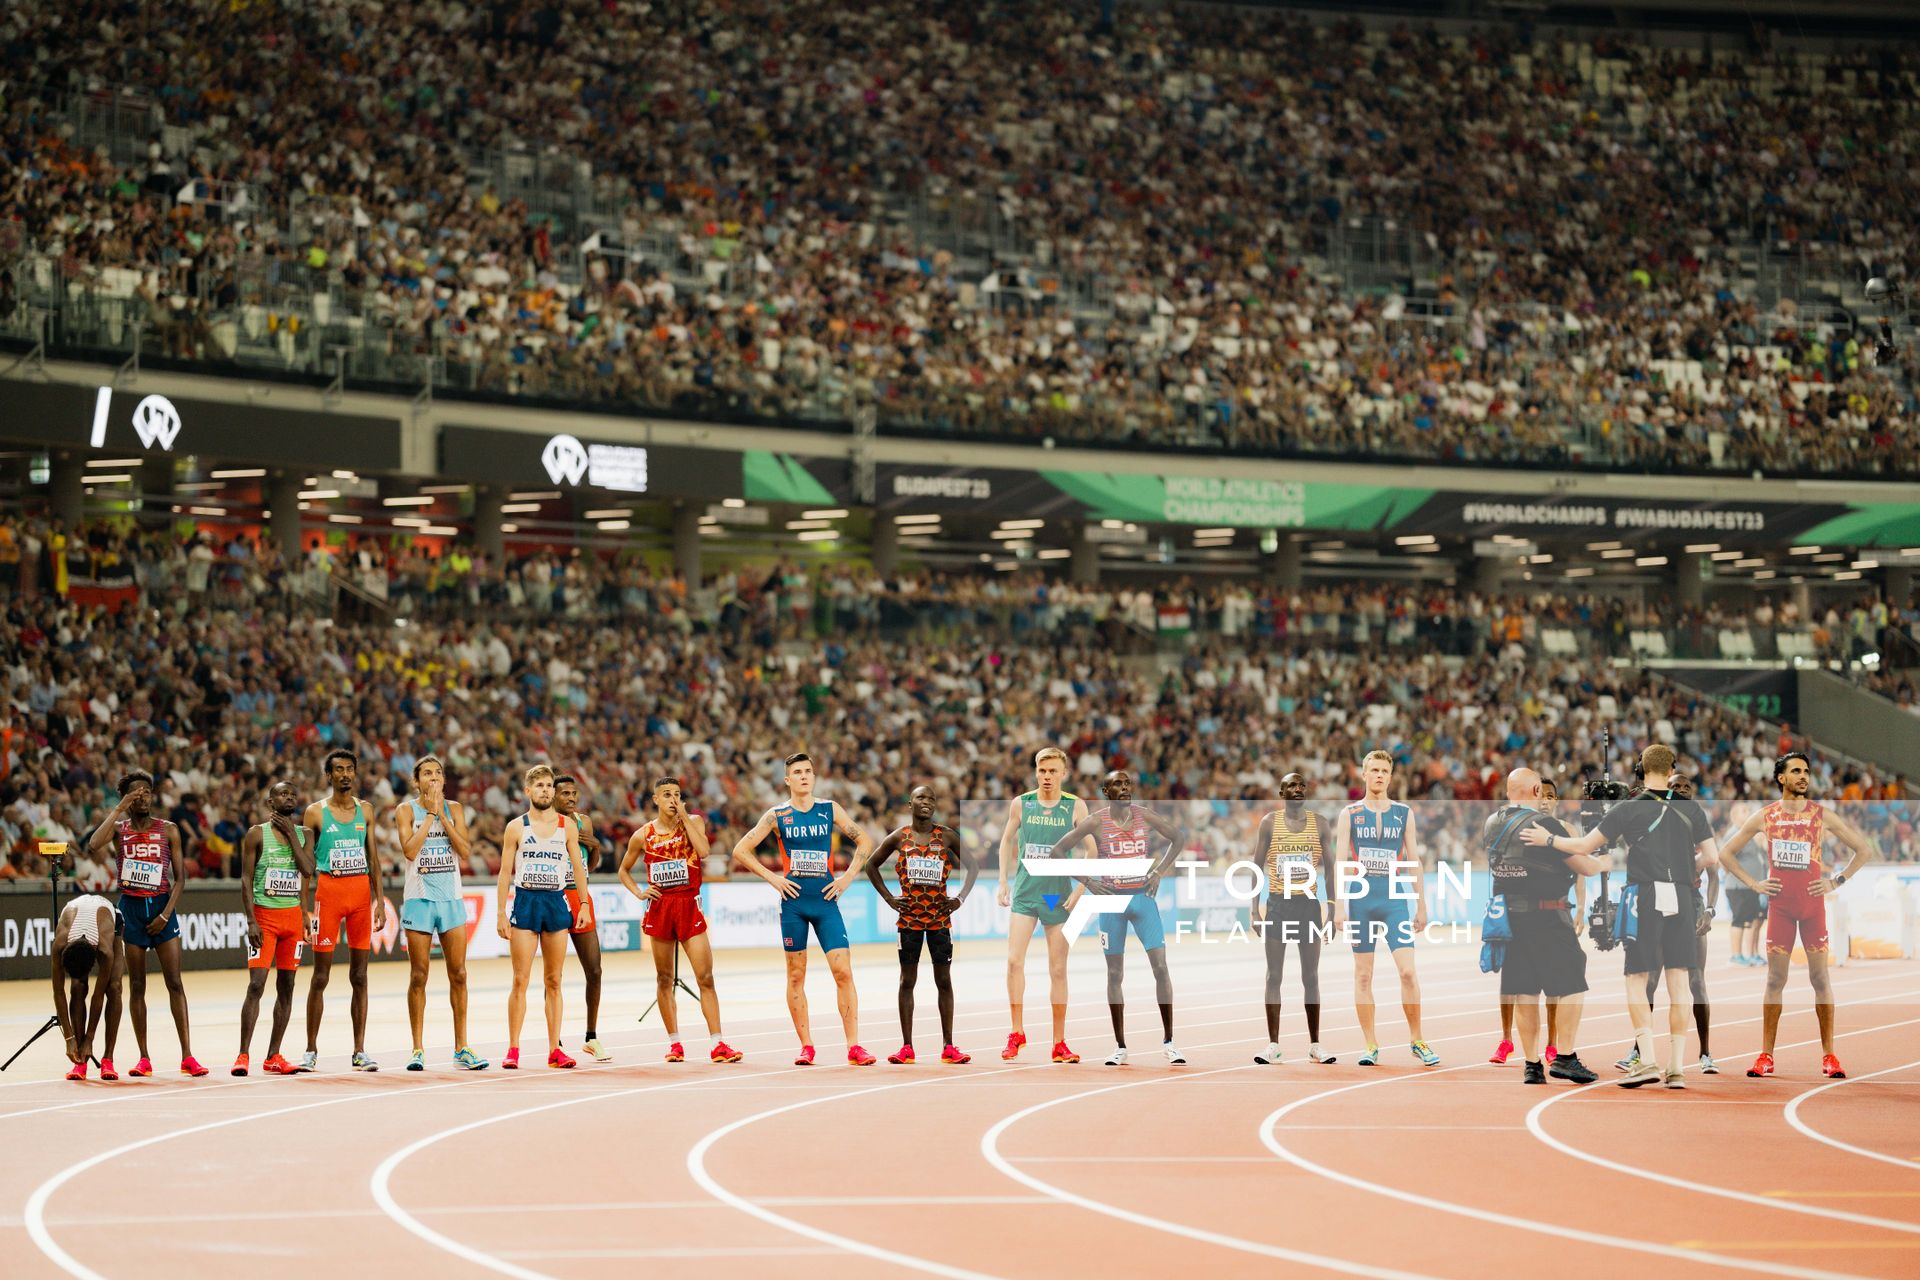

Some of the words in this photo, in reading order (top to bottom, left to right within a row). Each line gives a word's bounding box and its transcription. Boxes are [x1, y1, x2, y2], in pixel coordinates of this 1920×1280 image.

[1165, 477, 1219, 499] WORLD
[1224, 480, 1305, 503] ATHLETICS
[1164, 499, 1305, 526] CHAMPIONSHIPS
[1463, 503, 1607, 526] #WORLDCHAMPS
[1615, 508, 1764, 531] #WABUDAPEST23
[1026, 815, 1066, 827] AUSTRALIA
[785, 823, 828, 839] NORWAY
[123, 843, 161, 859] USA
[428, 846, 452, 856] TDK
[1035, 845, 1052, 854] TD
[1109, 839, 1146, 855] USA
[1782, 841, 1808, 852] TDK
[340, 848, 363, 858] TDK
[522, 851, 563, 861] FRANCE
[800, 851, 825, 861] TDK
[1286, 853, 1310, 862] TDK
[1369, 849, 1395, 859] TDK
[1777, 851, 1804, 862] KATIR
[331, 858, 366, 869] KEJELCHA
[419, 856, 454, 866] GRIJALVA
[659, 861, 684, 871] TDK
[916, 859, 941, 870] TDK
[1360, 859, 1389, 870] NORDA
[133, 861, 160, 874] TDK
[531, 863, 558, 873] TDK
[131, 871, 150, 883] NUR
[277, 869, 300, 880] TDK
[522, 873, 559, 884] GRESSIER
[653, 869, 686, 882] OUMAIZ
[908, 868, 941, 880] KIPKURUI
[270, 879, 299, 890] ISMAIL
